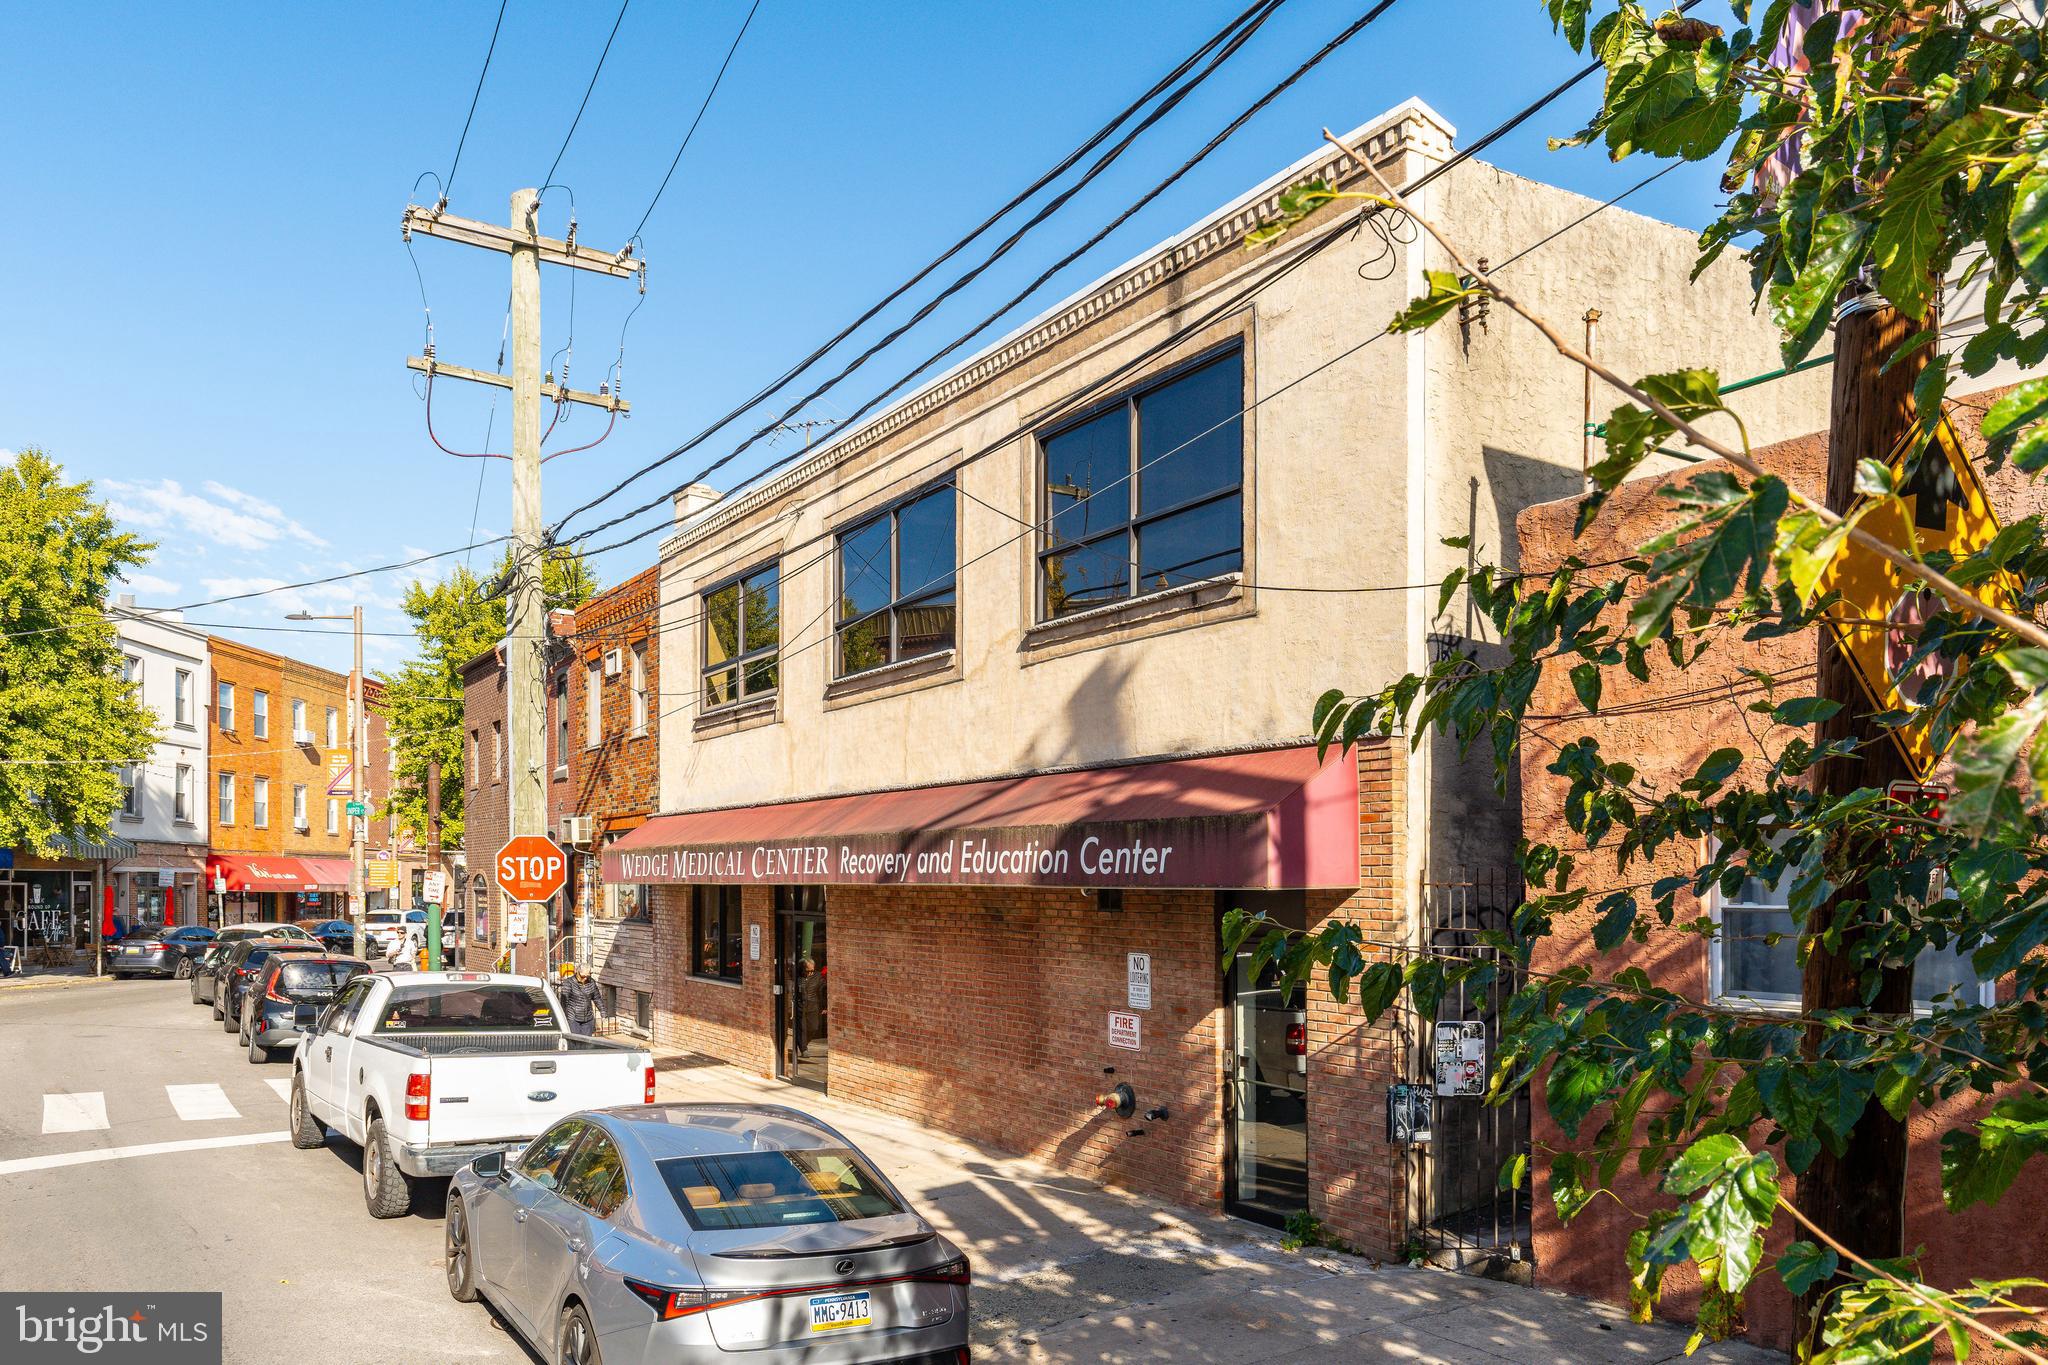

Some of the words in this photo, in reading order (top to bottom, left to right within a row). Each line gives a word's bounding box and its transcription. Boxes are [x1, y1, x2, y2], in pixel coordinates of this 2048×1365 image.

[621, 853, 669, 879] WEDGE
[672, 850, 746, 878] MEDICAL
[751, 846, 829, 878] CENTER
[840, 846, 911, 882] Recovery
[917, 839, 954, 874] and
[960, 838, 1068, 874] Education
[1080, 836, 1173, 875] Center
[501, 856, 561, 881] STOP
[1133, 957, 1145, 971] NO
[1129, 971, 1149, 985] LOITERING
[1114, 1016, 1134, 1030] FIRE
[1111, 1028, 1137, 1038] DEPARTMENT
[1450, 1027, 1471, 1040] NO
[1111, 1036, 1137, 1046] CONNECTION
